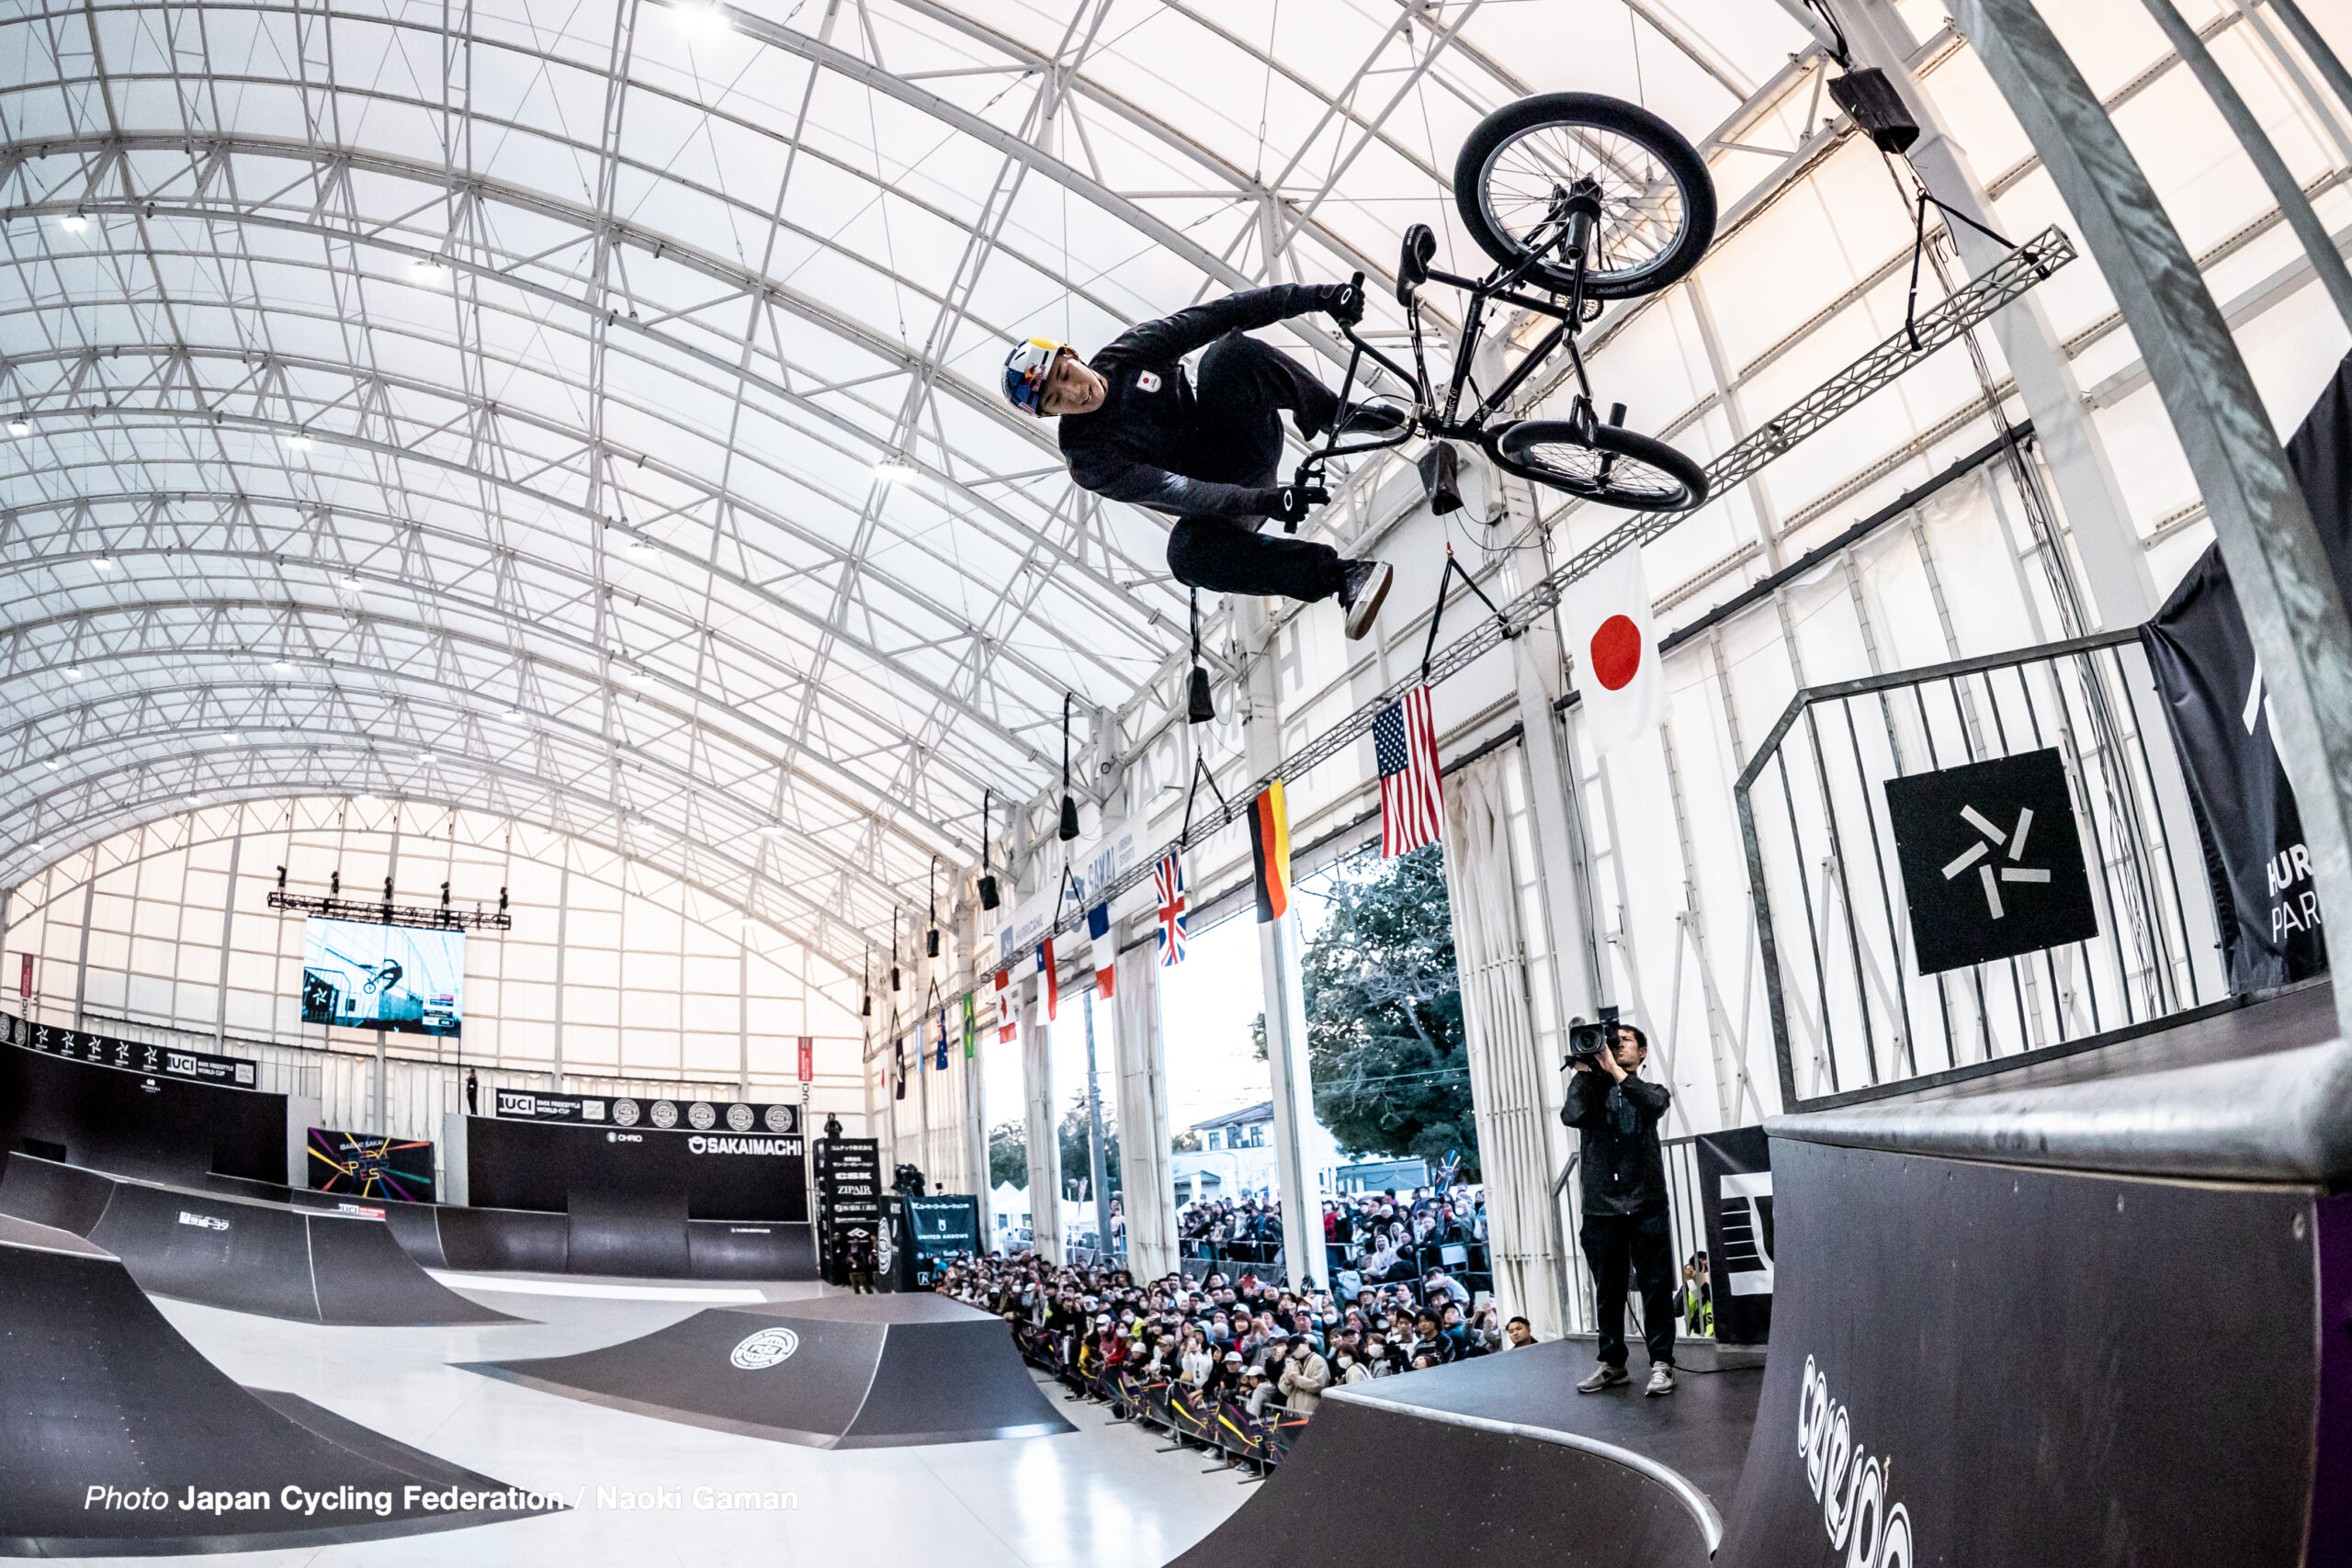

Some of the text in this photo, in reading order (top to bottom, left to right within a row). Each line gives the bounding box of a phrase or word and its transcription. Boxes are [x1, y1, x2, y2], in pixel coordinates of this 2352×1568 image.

[2266, 843, 2315, 897] HUR
[2271, 890, 2322, 943] PAR
[209, 1062, 234, 1072] FREESTYLE
[505, 1098, 532, 1111] UCI
[537, 1106, 558, 1114] WORLD
[365, 1139, 384, 1147] SAKAI
[707, 1137, 802, 1156] SAKAIMACHI
[835, 1172, 872, 1180] CSK
[837, 1185, 873, 1196] ZIPAIR
